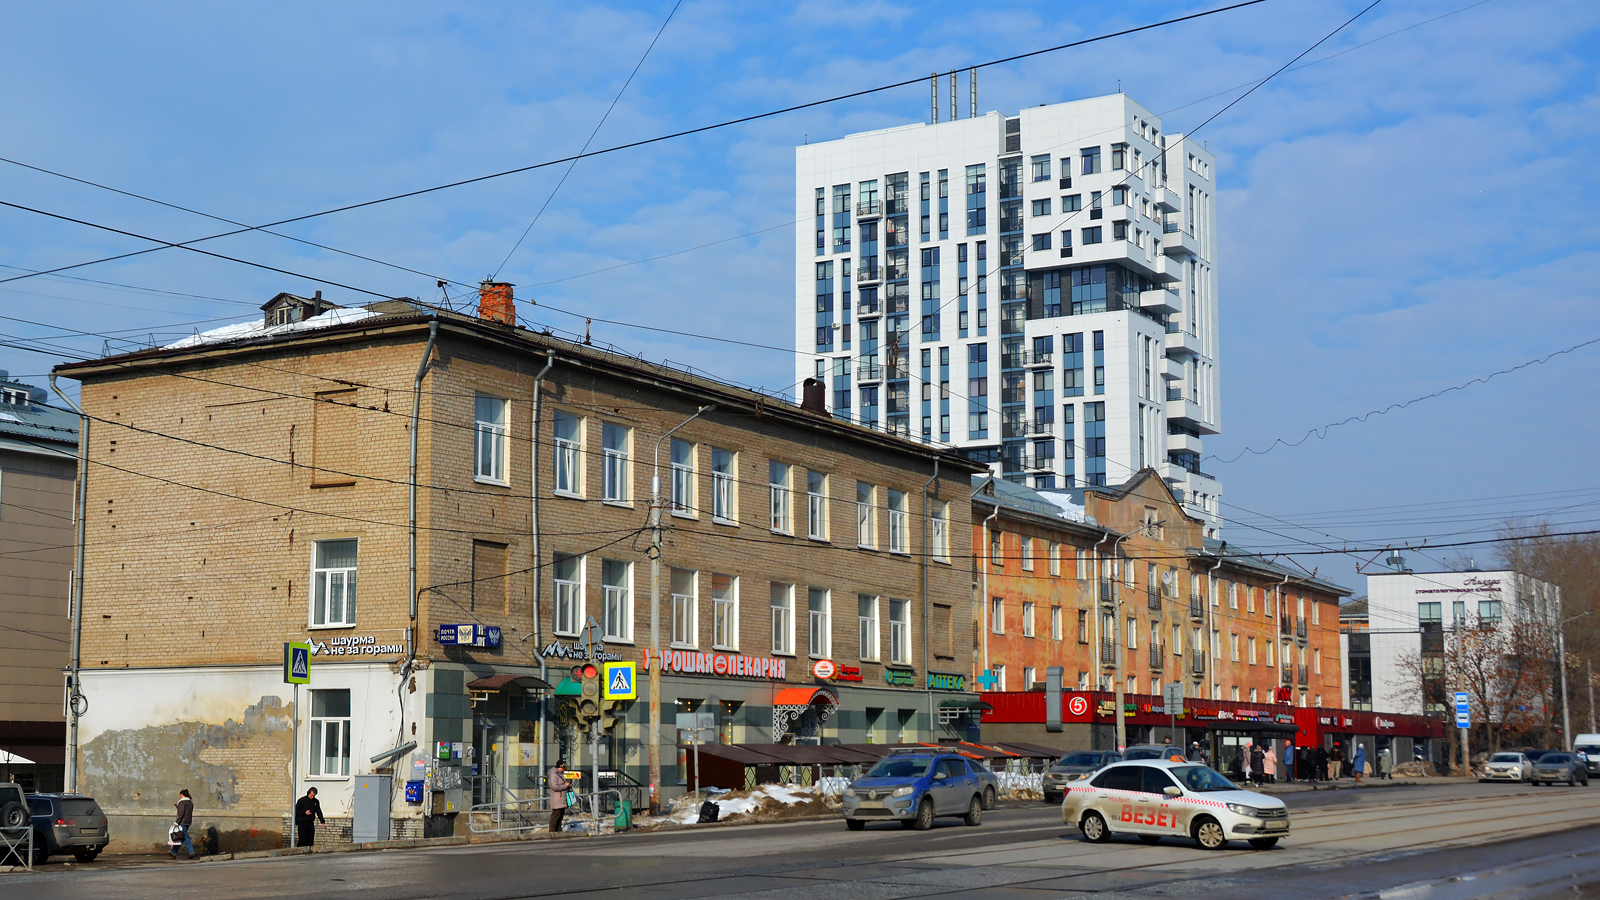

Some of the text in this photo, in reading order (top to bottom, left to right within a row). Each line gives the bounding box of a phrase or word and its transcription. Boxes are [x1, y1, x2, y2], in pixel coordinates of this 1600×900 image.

[331, 636, 375, 646] шаурма
[331, 645, 403, 656] не за горами
[727, 655, 786, 679] ПЕКАРНЯ
[928, 673, 965, 690] АПТЕКА
[1073, 699, 1083, 711] 5
[1108, 796, 1131, 804] РЕАЛЬНО
[1120, 803, 1181, 829] ВЕЗЁТ
